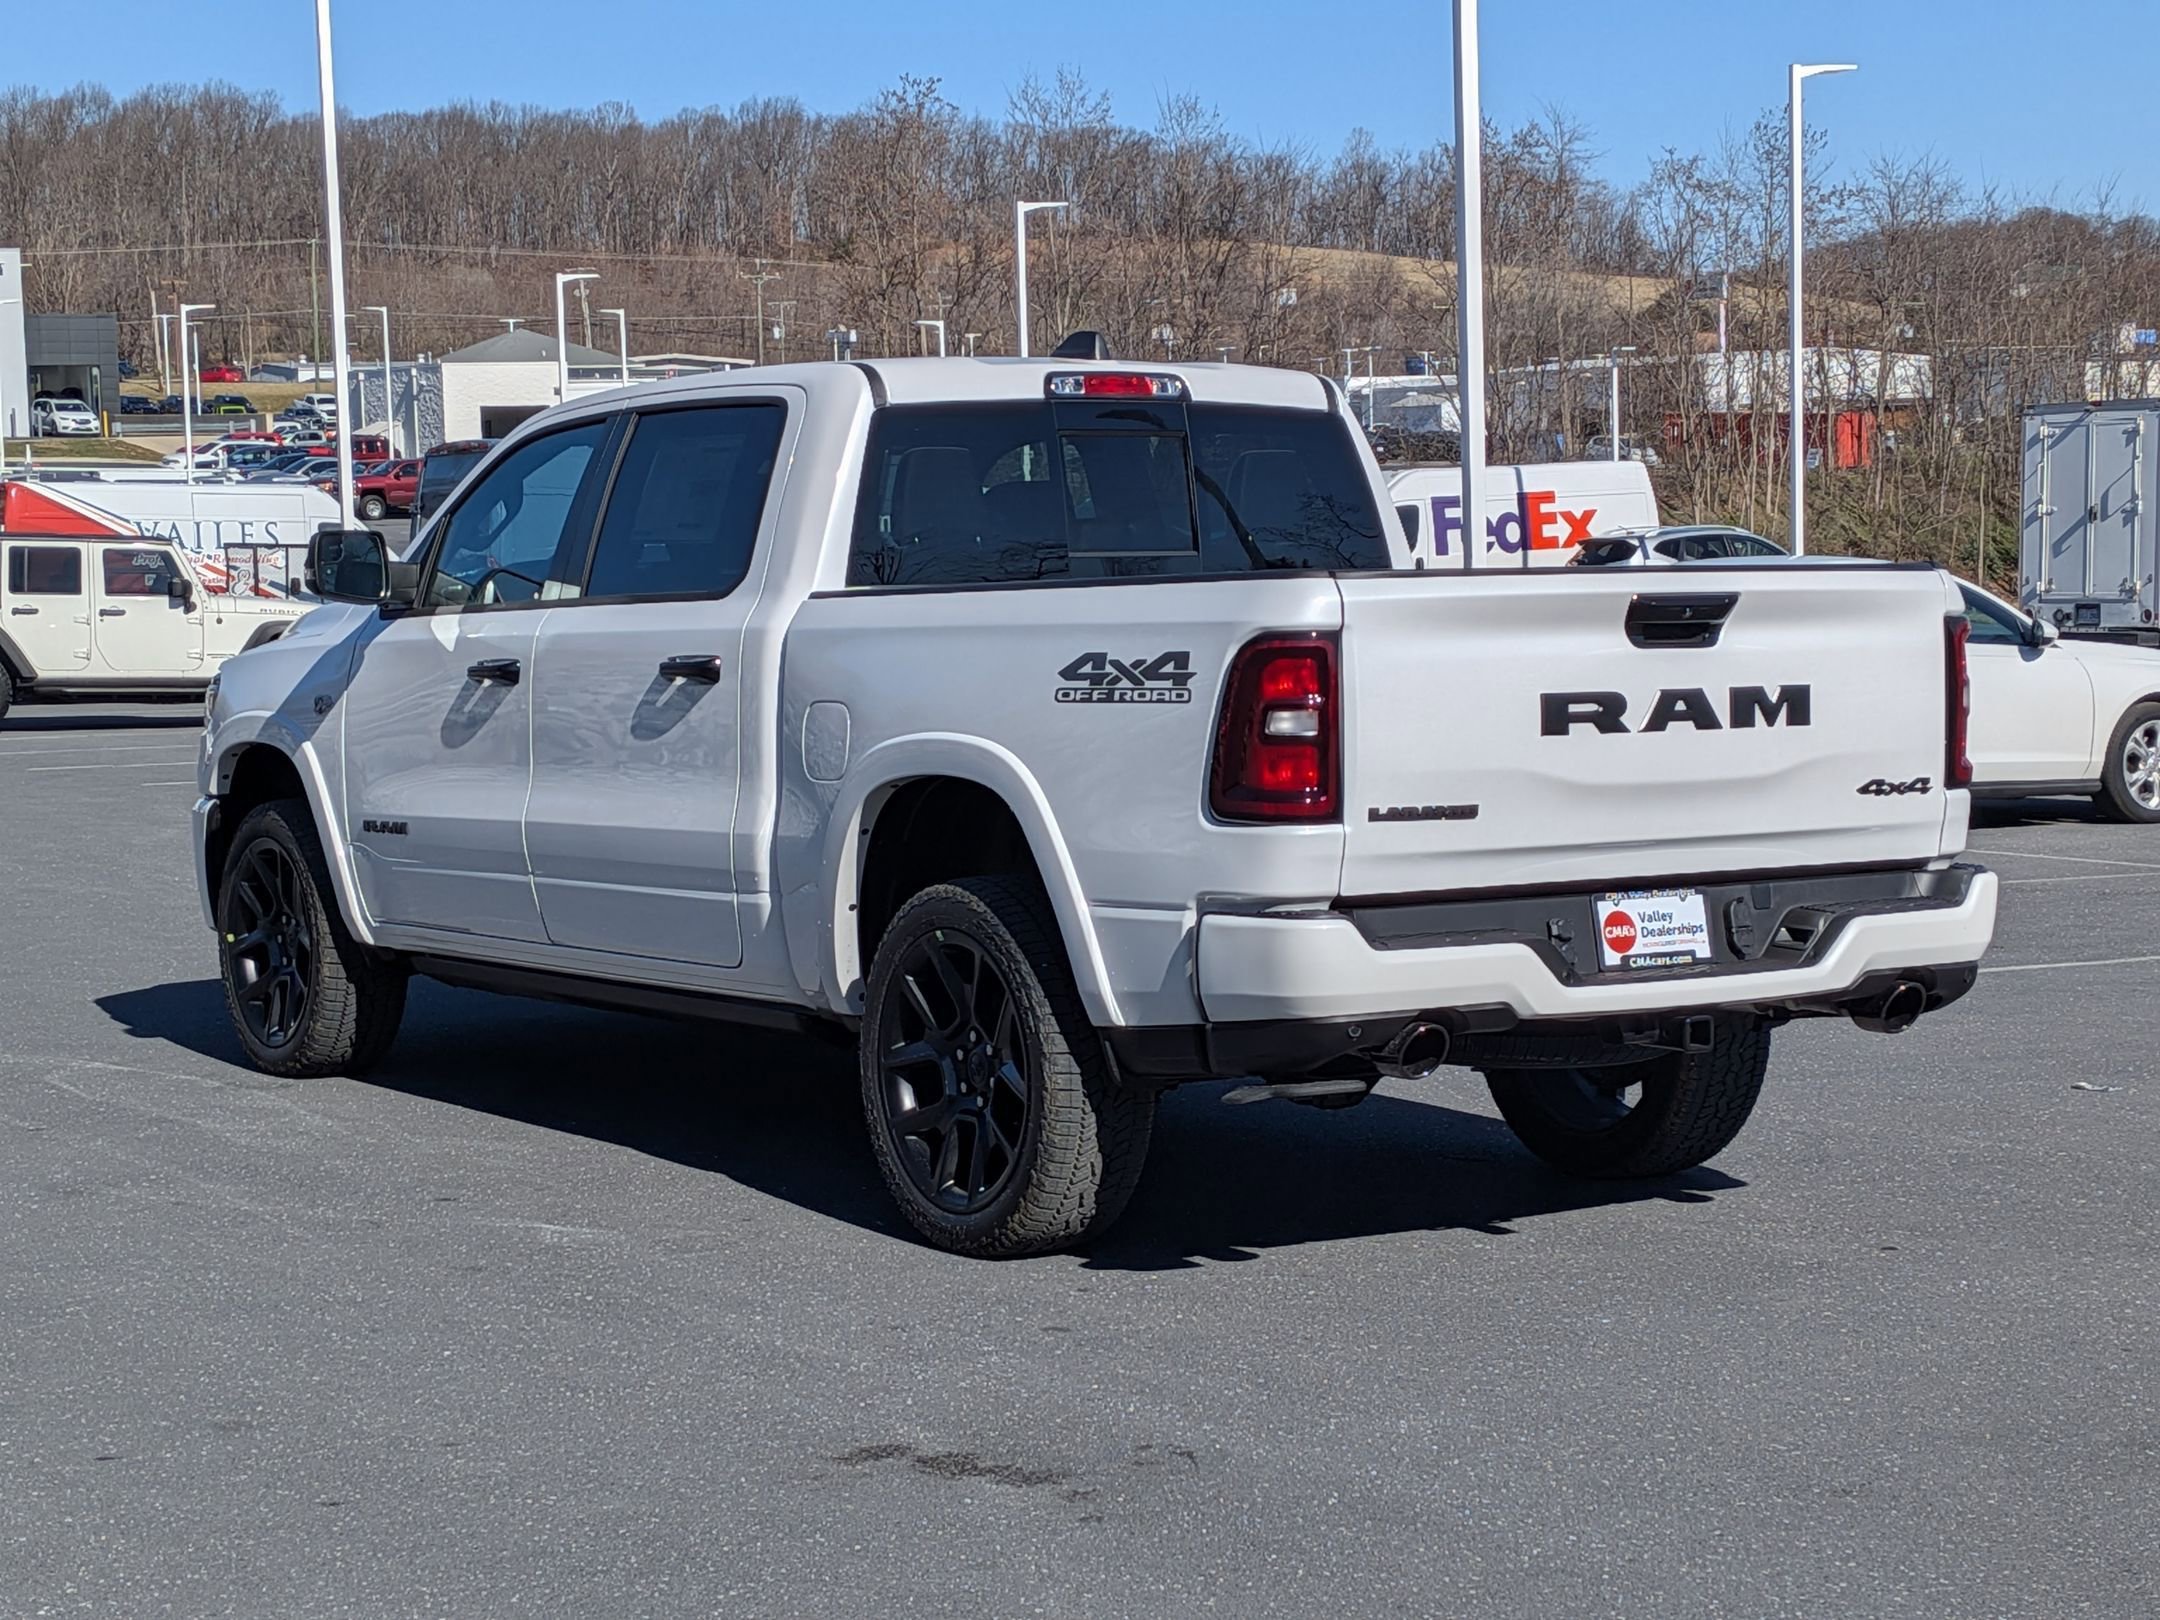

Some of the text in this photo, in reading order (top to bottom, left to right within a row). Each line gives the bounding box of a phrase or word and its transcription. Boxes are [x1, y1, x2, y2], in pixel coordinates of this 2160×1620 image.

[1430, 491, 1597, 556] FdEx
[1057, 651, 1198, 687] 4x4
[1056, 689, 1190, 702] OFF ROAD
[1540, 684, 1811, 737] RAM
[1856, 776, 1933, 797] 4x4
[1637, 910, 1673, 924] Valley
[1604, 924, 1636, 939] CMA's
[1641, 922, 1705, 939] Dealerships
